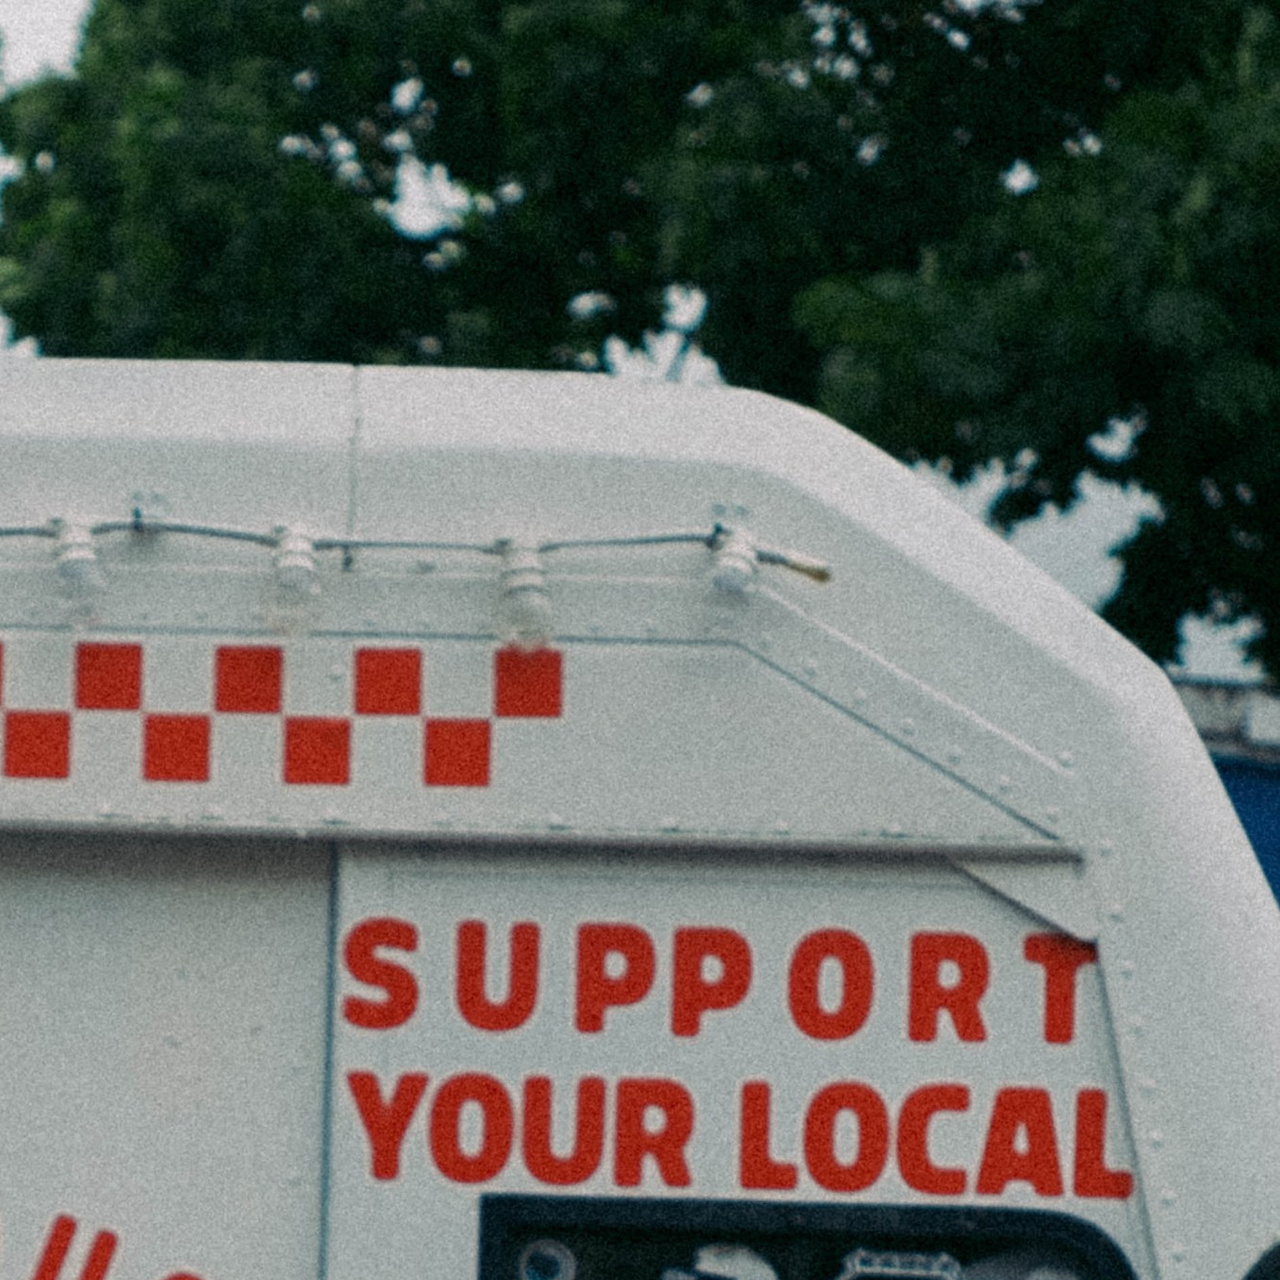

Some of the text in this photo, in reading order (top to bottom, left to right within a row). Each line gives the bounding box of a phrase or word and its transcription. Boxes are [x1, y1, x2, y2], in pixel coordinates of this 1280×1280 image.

[342, 917, 1096, 1045] SUPPORT
[347, 1070, 1134, 1200] YOUR LOCAL
